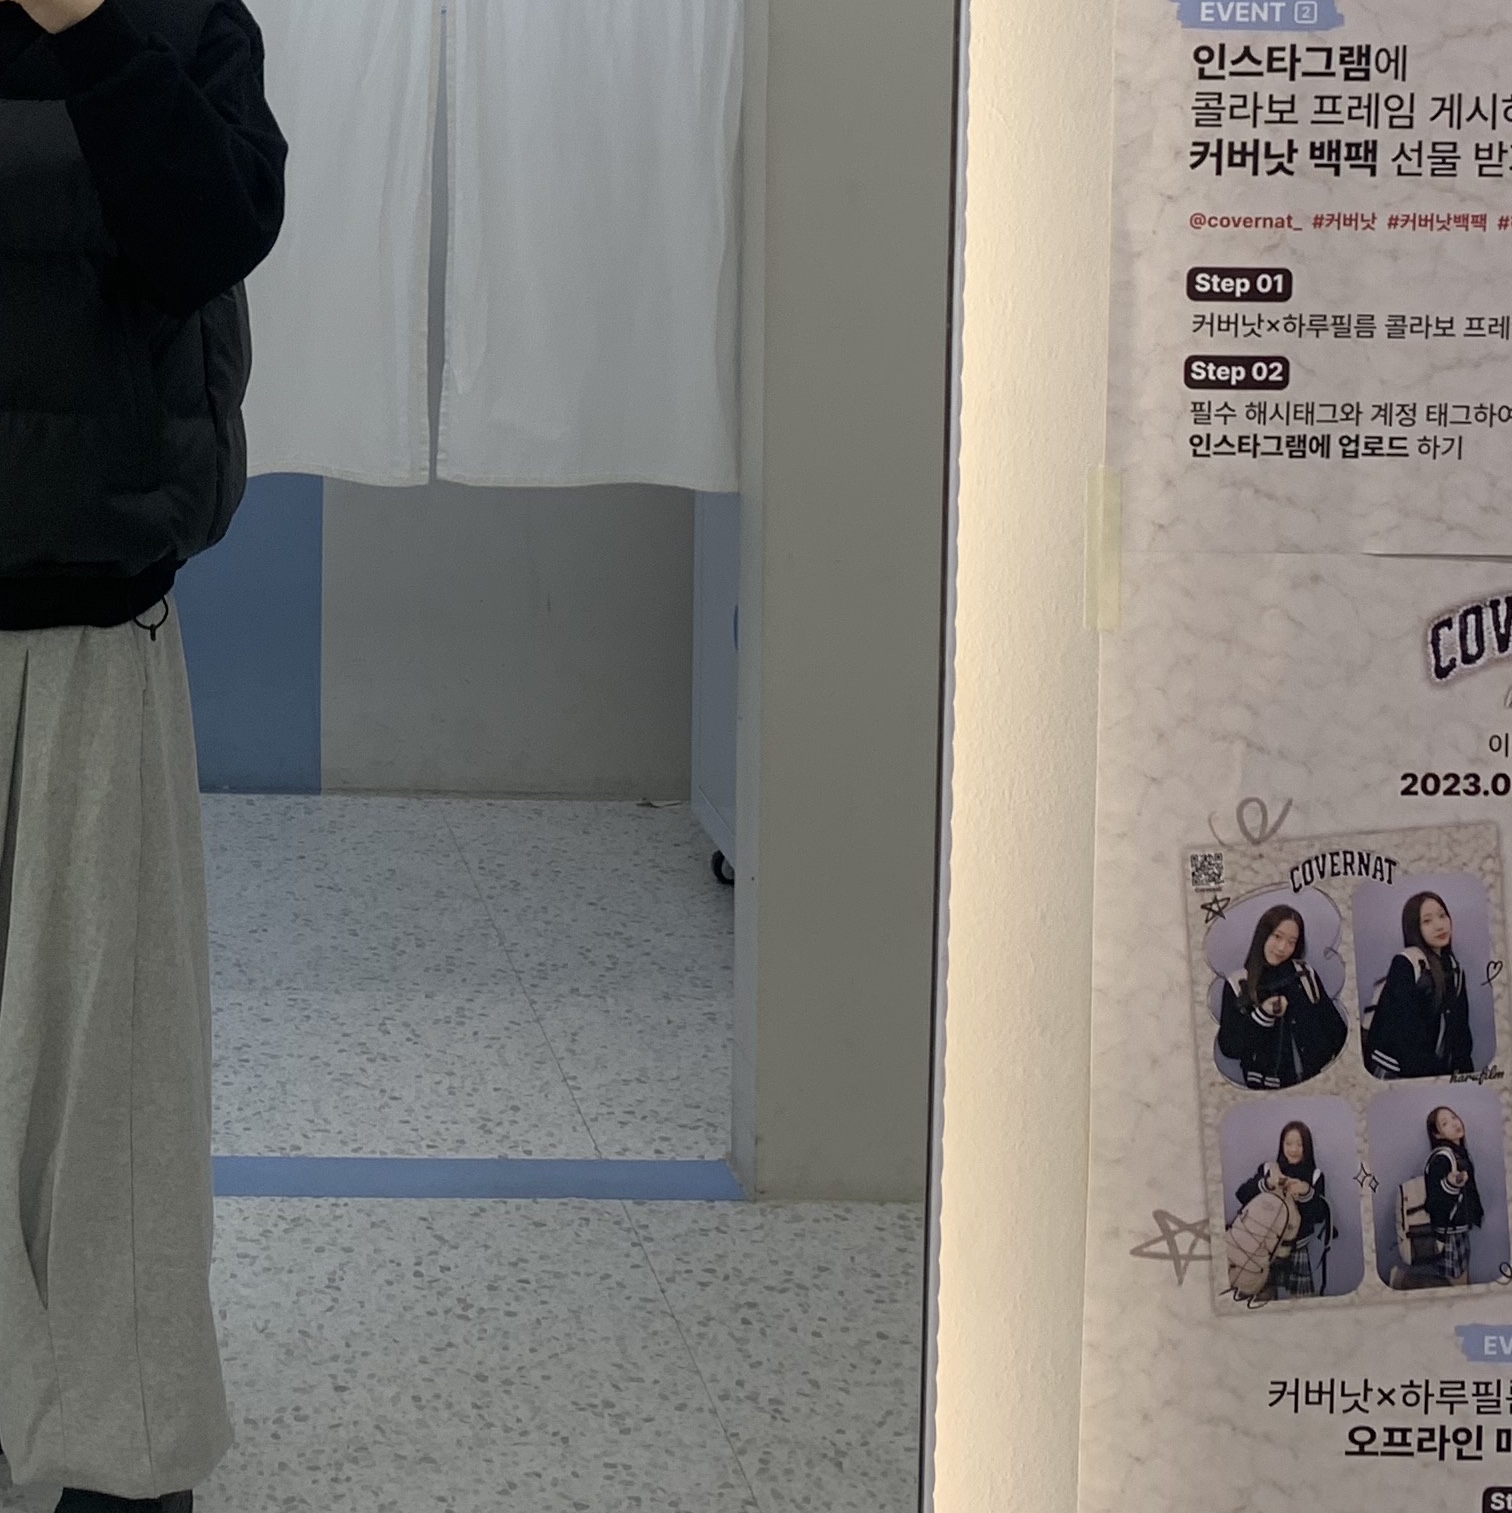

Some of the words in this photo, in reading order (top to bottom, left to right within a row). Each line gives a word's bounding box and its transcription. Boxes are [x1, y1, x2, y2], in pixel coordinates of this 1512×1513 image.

[1200, 1, 1286, 23] EVENT
[1192, 43, 1408, 82] 인스타그램에
[1191, 91, 1299, 129] 콜라보
[1310, 92, 1415, 130] 프레임
[1189, 138, 1299, 177] 커버낫
[1309, 139, 1378, 178] 백팩
[1391, 140, 1462, 178] 선물
[1474, 140, 1512, 178] 받
[1189, 213, 1304, 232] @covernat_
[1311, 212, 1377, 231] #커버낫
[1387, 212, 1487, 232] #커버낫백팩
[1194, 273, 1250, 297] Step
[1256, 273, 1284, 294] 01
[1384, 314, 1456, 340] 콜라보
[1463, 315, 1511, 341] 프레
[1190, 361, 1246, 386] Step
[1251, 361, 1284, 382] 02
[1189, 400, 1238, 426] 필수
[1245, 401, 1364, 426] 해시태그와
[1370, 402, 1418, 427] 계정
[1189, 433, 1331, 459] 인스타그램에
[1338, 434, 1410, 459] 업로드
[1416, 435, 1464, 461] 하기
[1399, 772, 1512, 797] 2023.0
[1289, 850, 1397, 893] COVERNAT
[1344, 1425, 1483, 1462] 오프라인
